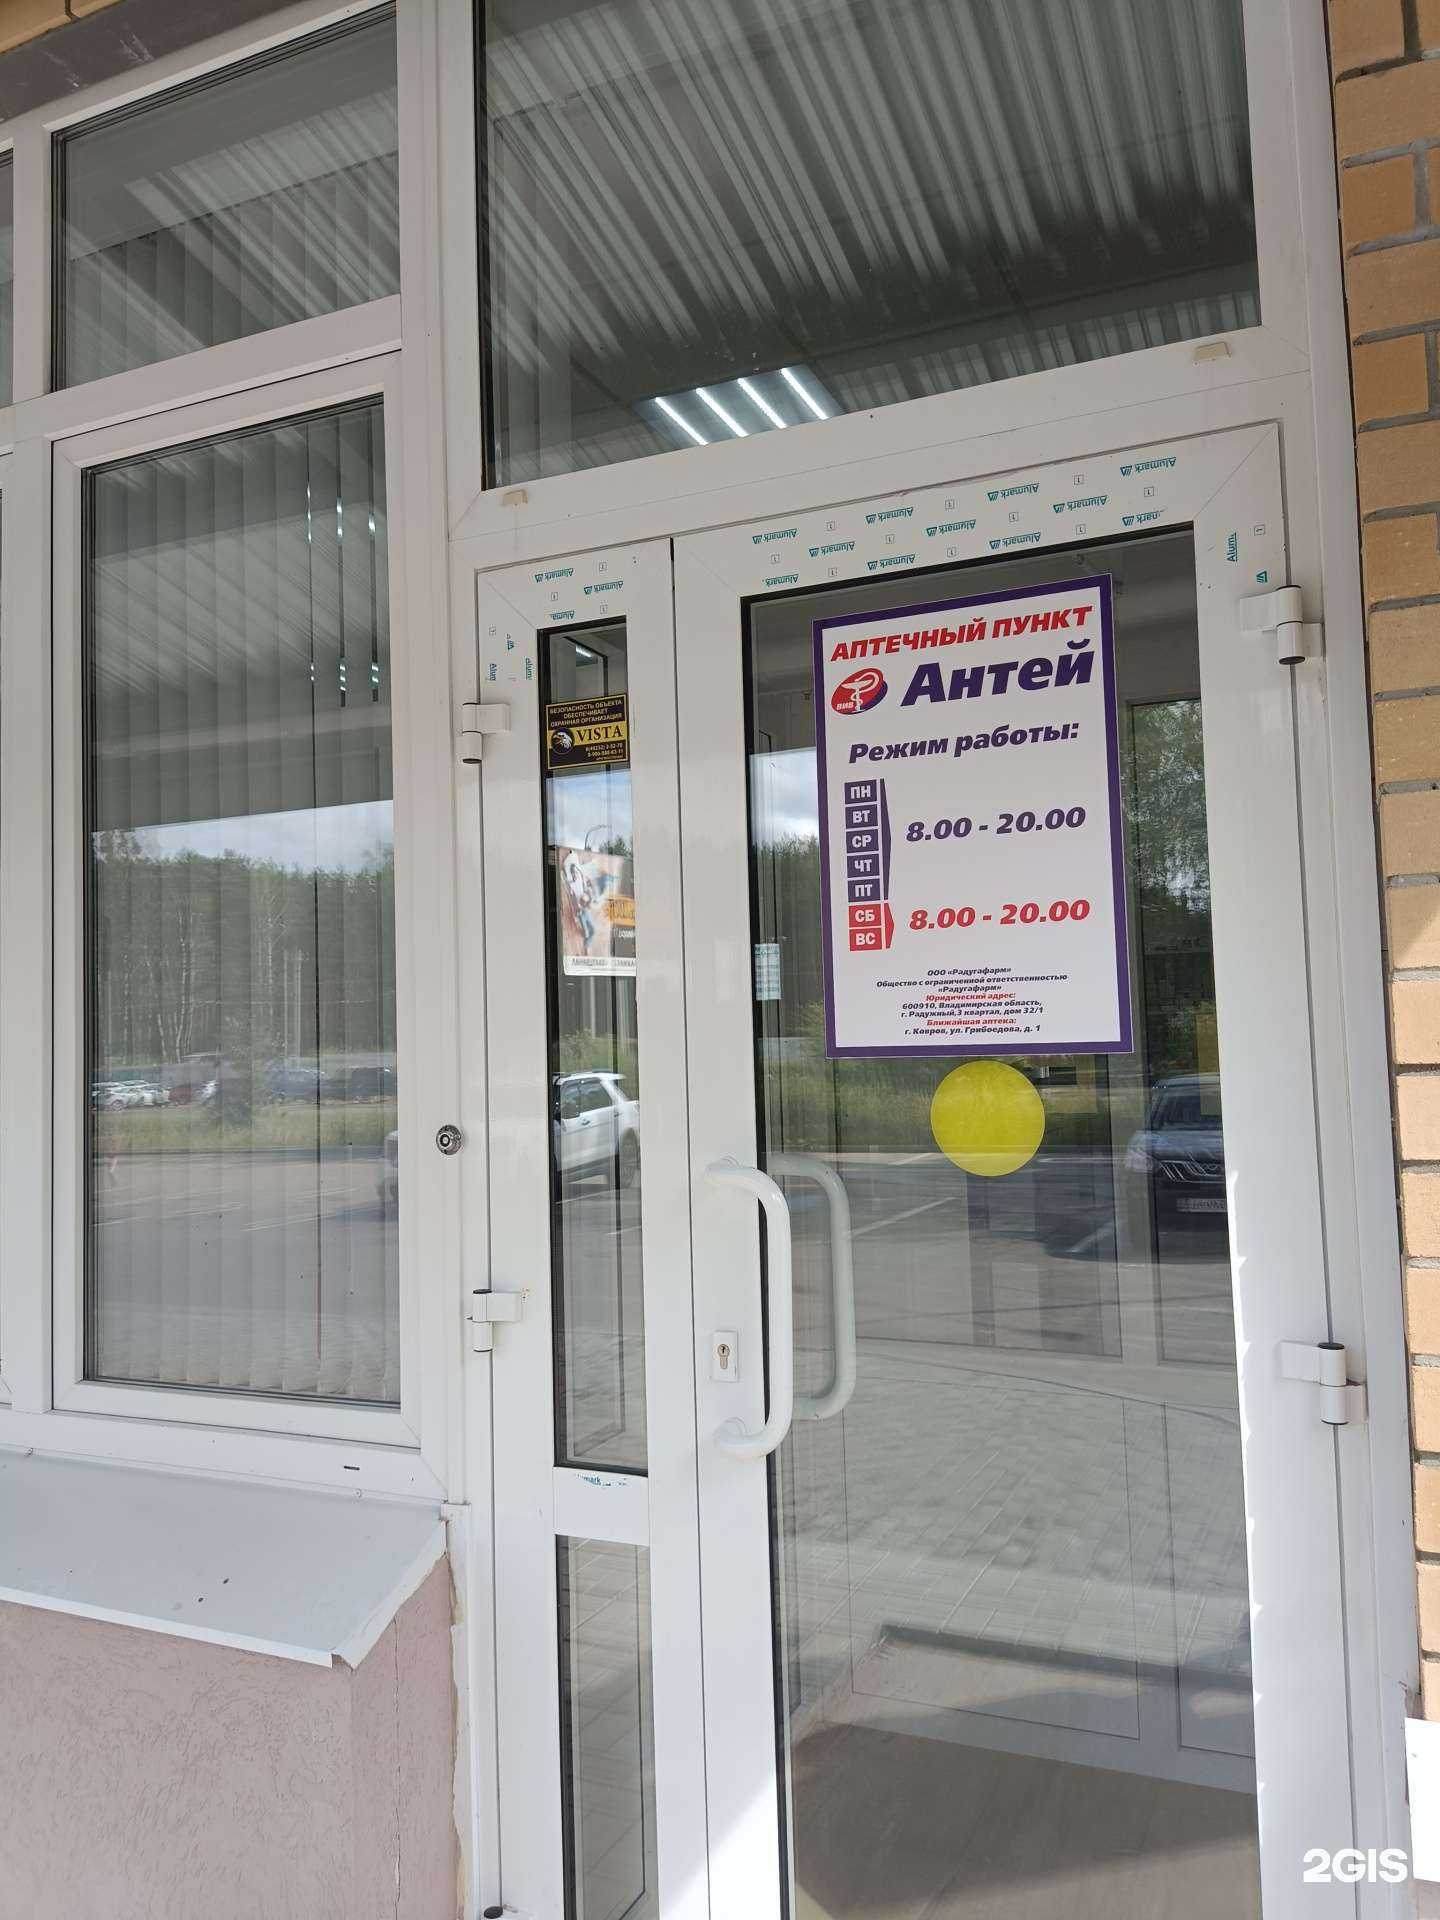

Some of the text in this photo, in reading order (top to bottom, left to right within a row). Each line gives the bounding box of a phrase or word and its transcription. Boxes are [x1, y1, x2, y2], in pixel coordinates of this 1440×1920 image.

[1135, 457, 1177, 473] Alumark
[1000, 483, 1040, 499] Alumark
[1066, 495, 1108, 512] Alumark
[878, 507, 914, 523] Alumark
[939, 519, 976, 535] Alumark
[763, 528, 797, 543] Alumark
[1003, 532, 1041, 547] Alumark
[821, 541, 855, 556] Alumark
[880, 554, 916, 568] Alumark
[545, 568, 574, 580] Alumark
[594, 581, 623, 593] Alumark
[831, 606, 1093, 662] АПТЕЧНЫЙ ПУНКТ
[900, 639, 1095, 707] Антей
[576, 725, 623, 742] VISTA
[849, 723, 1080, 764] Режим работы:
[850, 785, 871, 799] ПН
[852, 809, 871, 824] ВТ
[906, 817, 972, 842] 8.00
[996, 806, 1086, 835] 20.00
[852, 834, 872, 848] СР
[854, 859, 872, 873] ЧТ
[854, 884, 873, 898] ПТ
[854, 909, 875, 923] СБ
[909, 907, 976, 930] 8.00
[999, 899, 1090, 925] 20.00
[855, 932, 876, 946] ВС
[927, 969, 946, 977] ООО
[876, 980, 918, 988] Общество
[924, 977, 985, 988] ограниченной
[986, 974, 1068, 983] ответственностью
[925, 992, 1016, 1002] Юридический адрес:
[902, 1002, 937, 1010] 600910,
[938, 1001, 1003, 1010] Владимирская
[963, 1009, 1002, 1017] квартал,
[1003, 1008, 1022, 1016] дом
[926, 1017, 1017, 1026] Ближайшая аптека:
[912, 1028, 949, 1036] Ковров,
[950, 1028, 963, 1036] ул.
